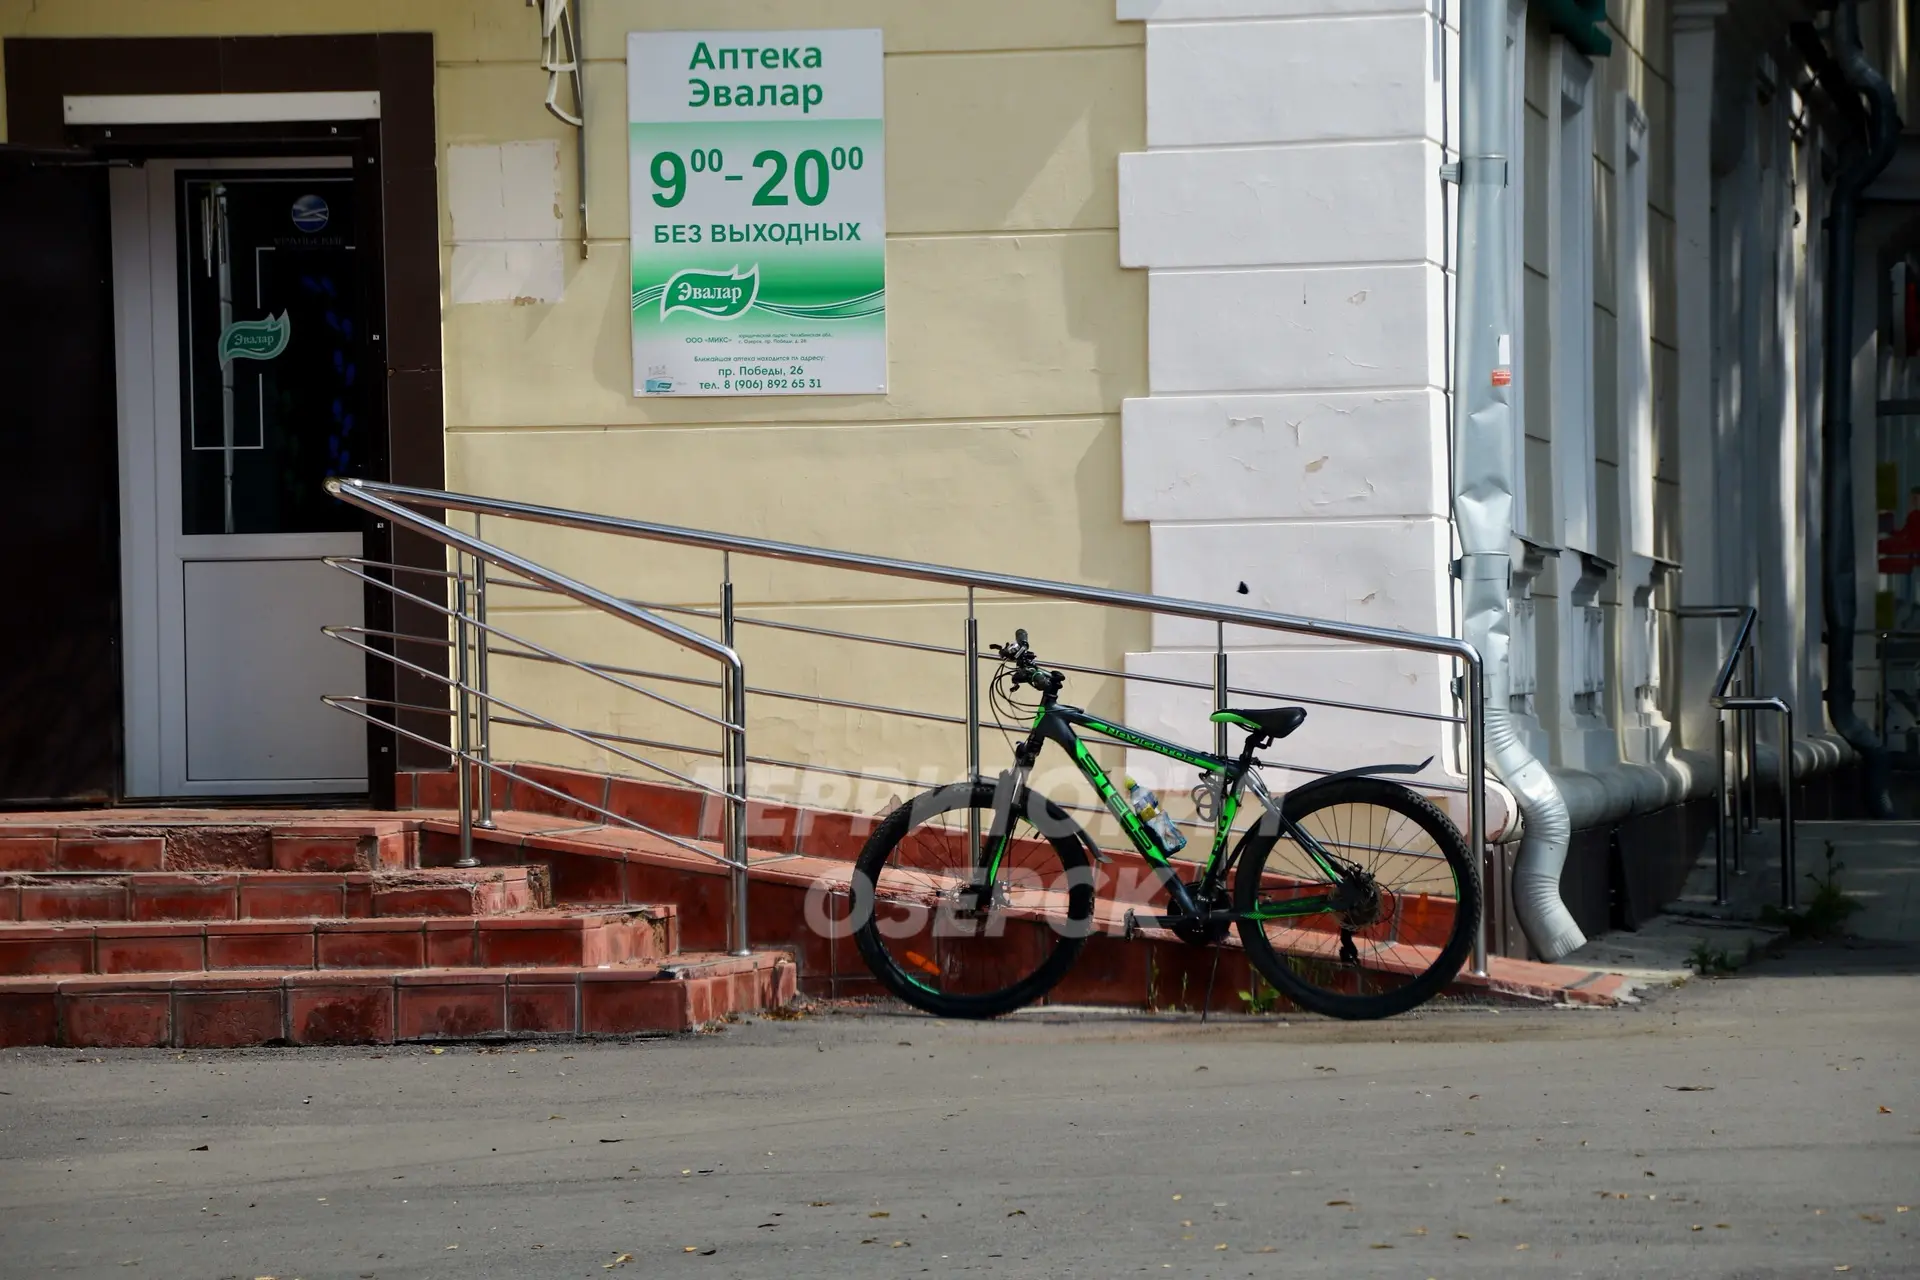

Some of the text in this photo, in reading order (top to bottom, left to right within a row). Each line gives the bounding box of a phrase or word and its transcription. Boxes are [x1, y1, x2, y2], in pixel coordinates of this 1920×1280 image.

[688, 41, 823, 71] Аптека
[688, 78, 824, 113] Эвалар
[654, 222, 861, 246] БЕЗ ВЫХОДНЫХ
[677, 282, 742, 304] Эвалар
[234, 334, 275, 346] Эвалар
[718, 365, 804, 378] пр. Победы, 26
[699, 378, 822, 391] тел. 8 (906) 892 65 31
[1105, 726, 1196, 762] NAVIGATOR
[1079, 752, 1153, 851] STELS
